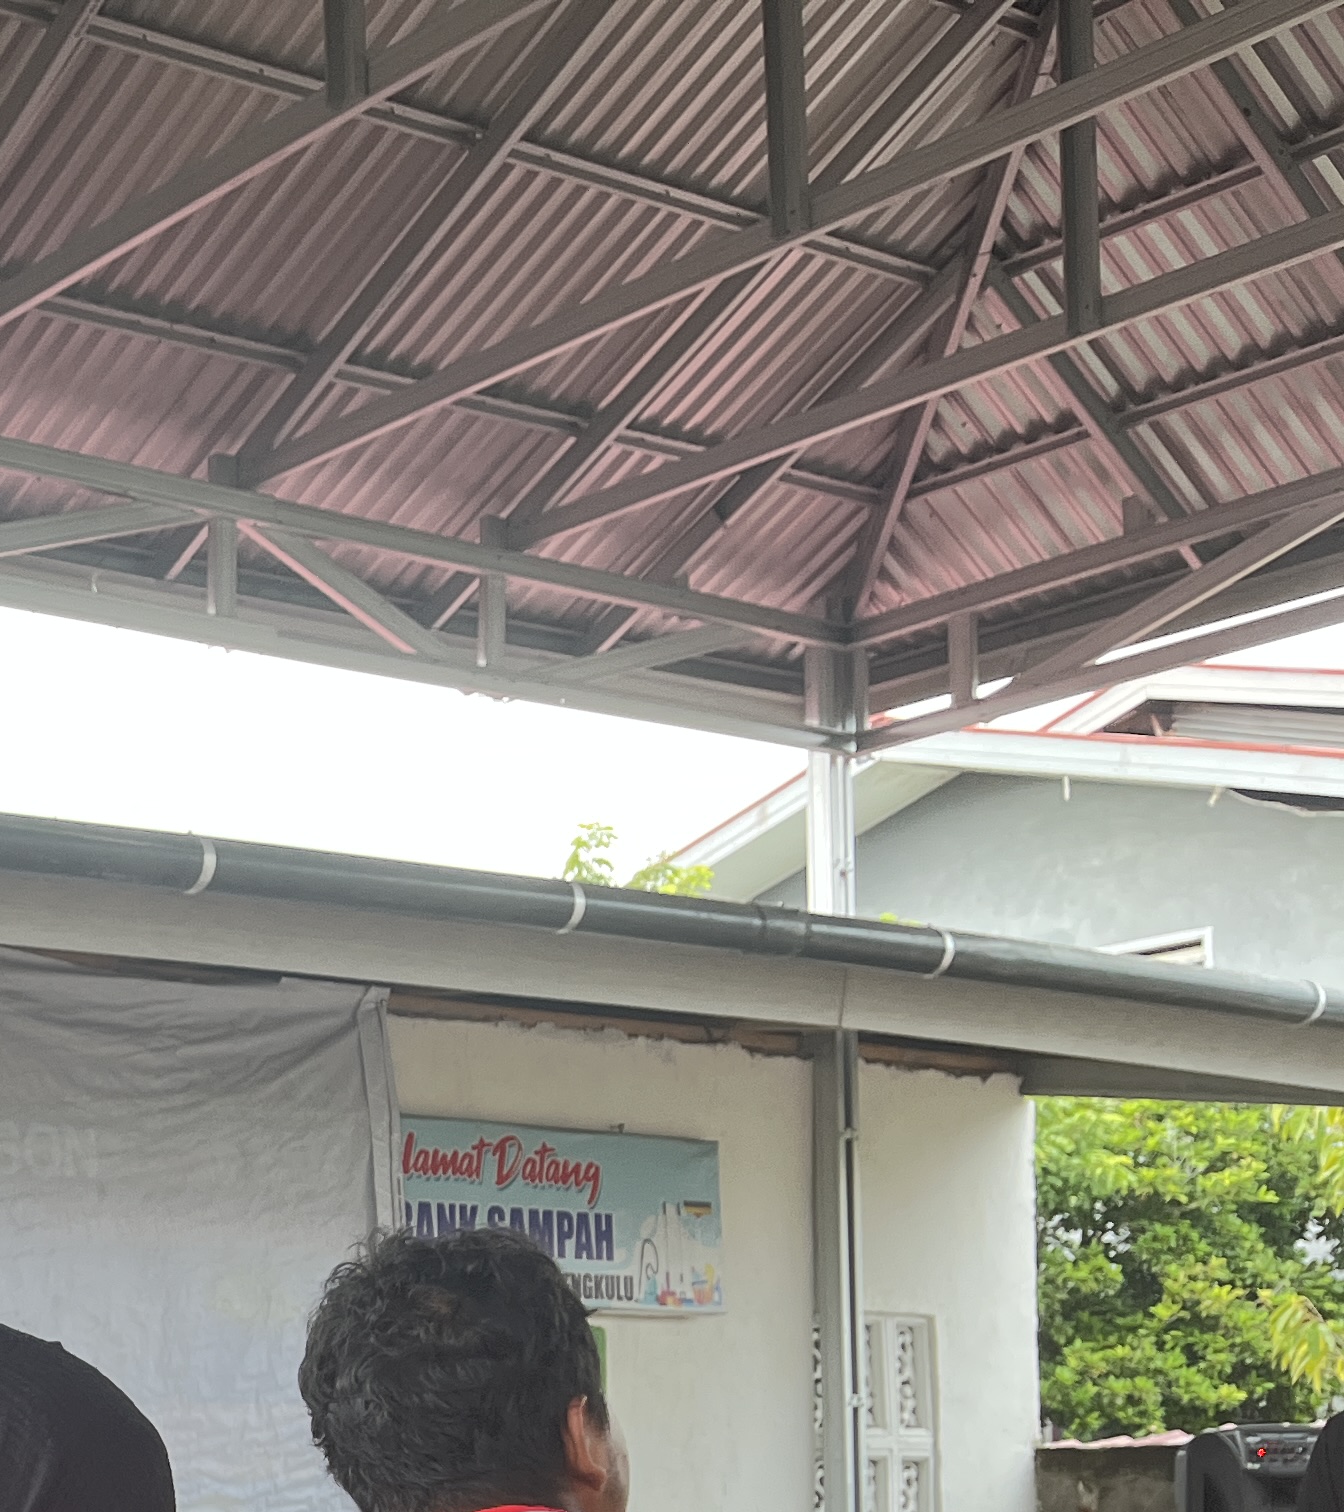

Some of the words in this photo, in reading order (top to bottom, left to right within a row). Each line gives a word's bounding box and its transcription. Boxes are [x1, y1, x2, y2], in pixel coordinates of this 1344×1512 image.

[402, 1131, 493, 1180] lamat
[492, 1134, 601, 1208] Datang
[405, 1200, 479, 1238] ANK
[566, 1271, 634, 1301] NGKULU
